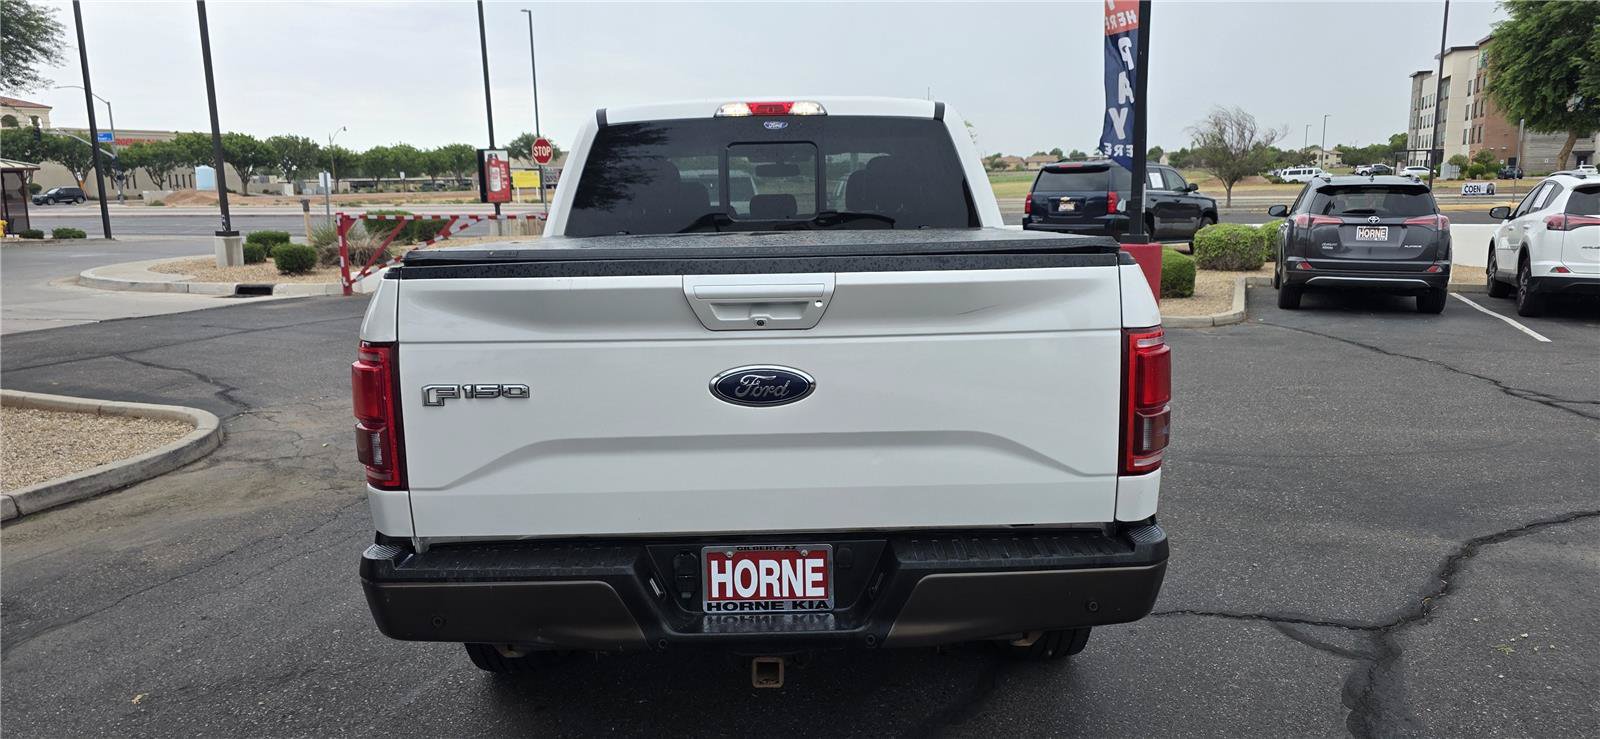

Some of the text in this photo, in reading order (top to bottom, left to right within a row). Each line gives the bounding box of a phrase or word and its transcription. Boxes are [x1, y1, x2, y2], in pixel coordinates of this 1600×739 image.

[533, 146, 551, 157] STOP
[1463, 185, 1481, 193] COEN
[1358, 228, 1387, 238] HORNE
[735, 374, 791, 398] Ford
[421, 383, 531, 407] F150
[710, 559, 825, 598] HORNE
[706, 600, 830, 612] HORNE KIA
